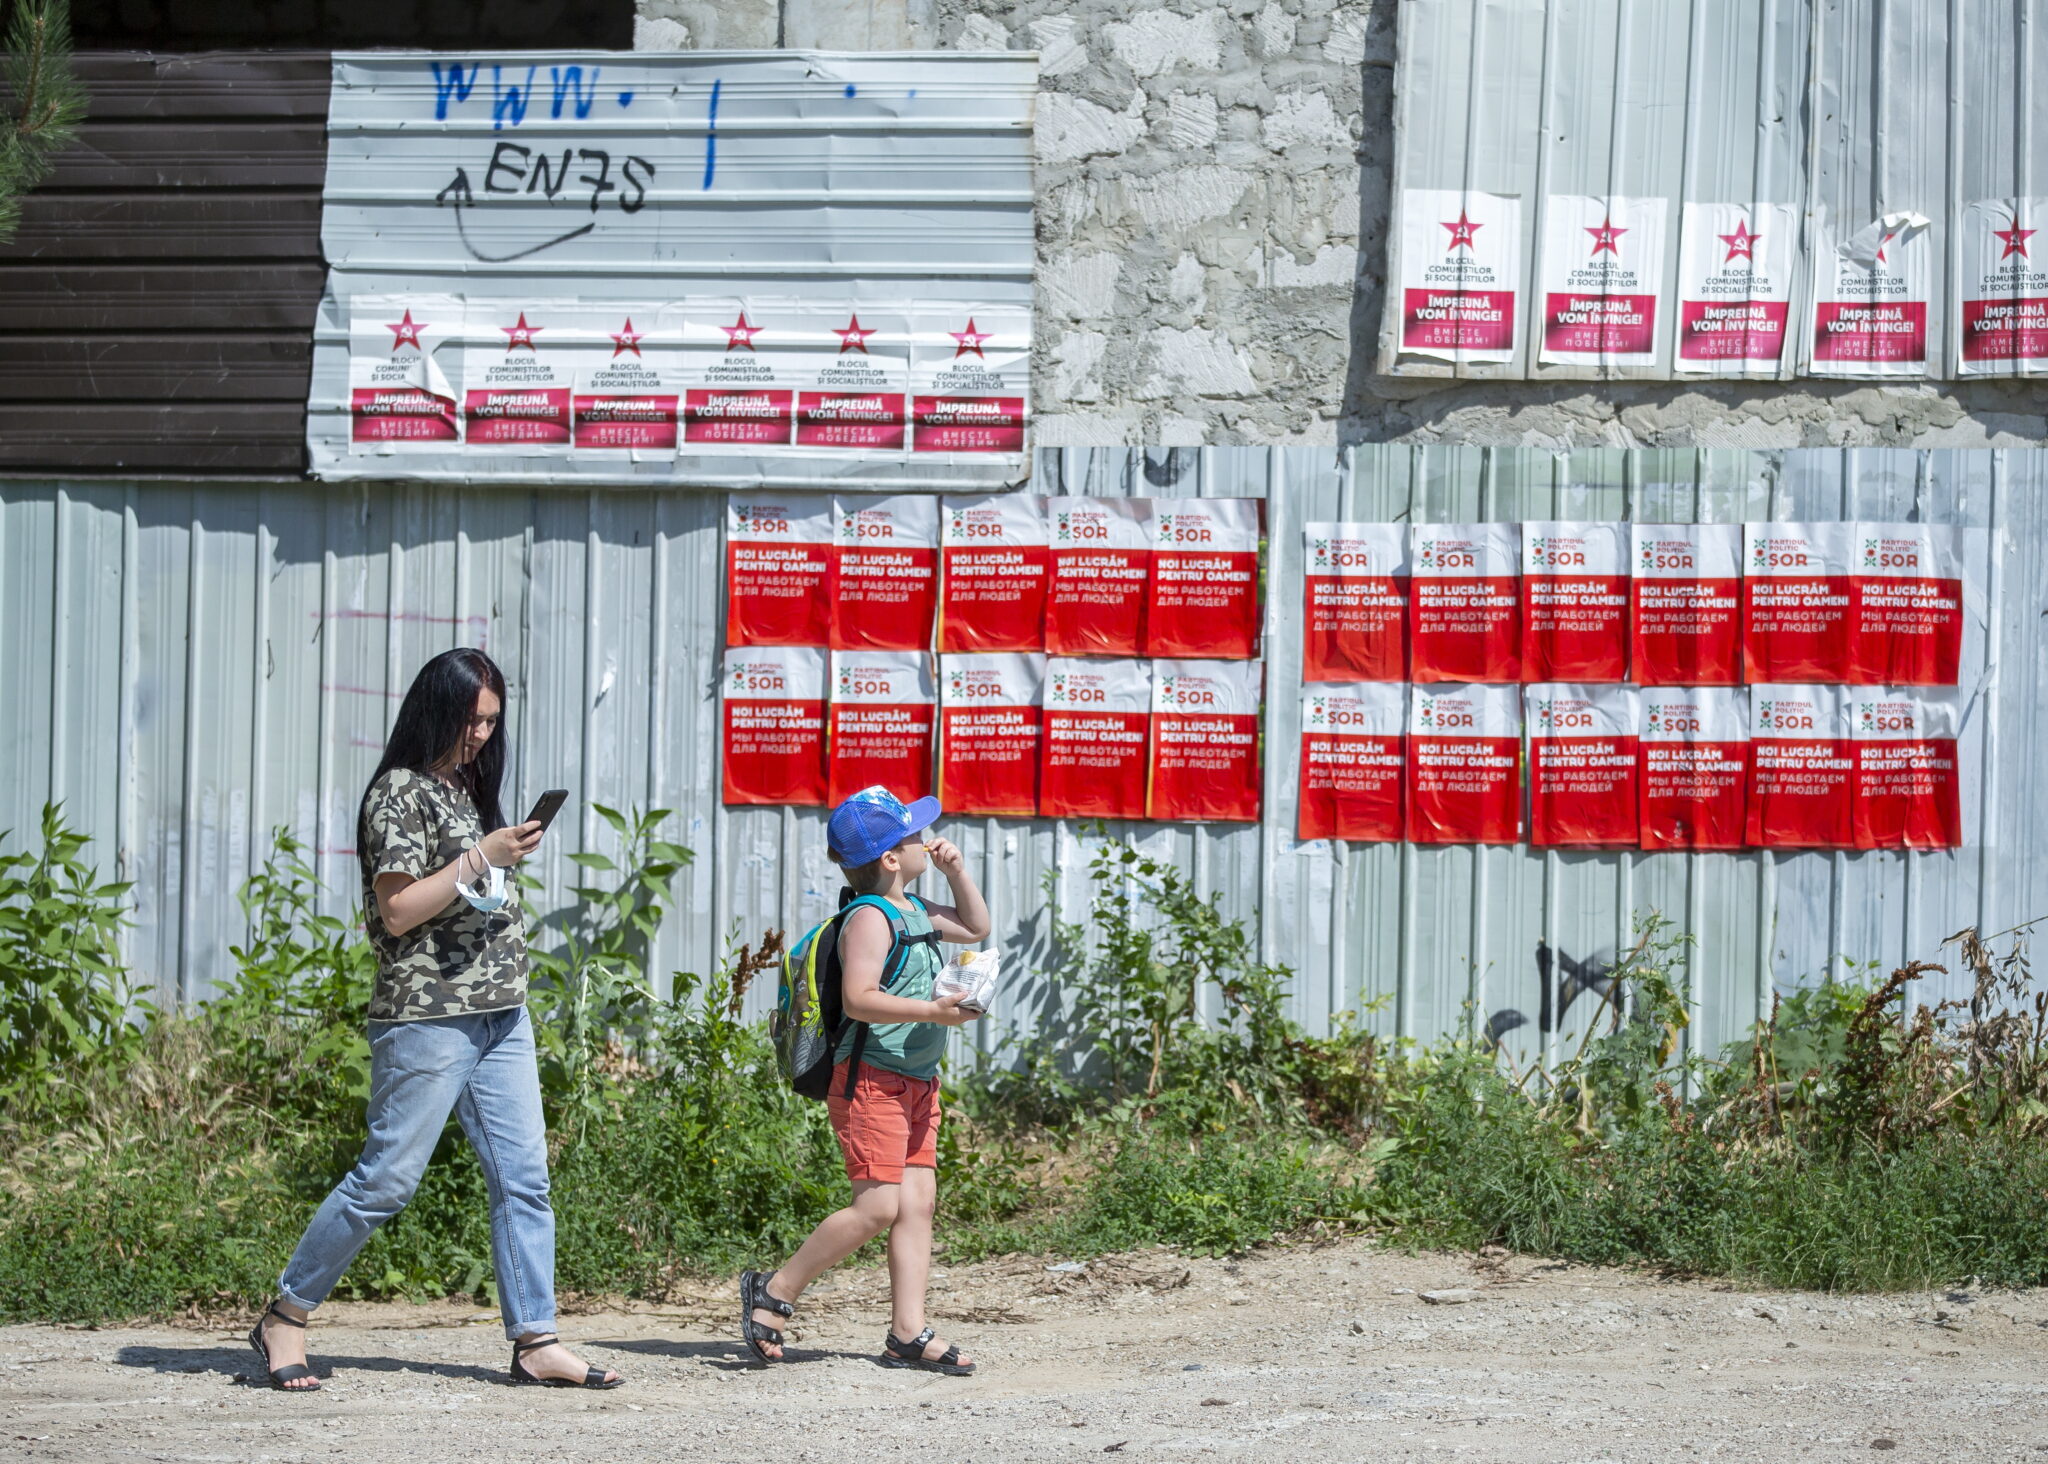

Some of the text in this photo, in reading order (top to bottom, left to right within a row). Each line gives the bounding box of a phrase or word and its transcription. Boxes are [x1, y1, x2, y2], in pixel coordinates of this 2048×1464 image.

[1428, 295, 1490, 308] ÎMPREUNĂ
[1416, 309, 1446, 320] VOM
[1557, 313, 1587, 324] VOM
[1692, 320, 1722, 331] VOM
[1827, 321, 1857, 332] VOM
[487, 393, 548, 405] ÎMPREUNĂ
[708, 395, 770, 407] ÎMPREUNĂ
[821, 396, 882, 411] ÎMPREUNĂ
[594, 399, 654, 411] ÎMPREUNĂ
[936, 400, 1000, 414] ÎMPREUNĂ
[475, 406, 504, 417] VOM
[695, 406, 780, 418] VOM ÎNVINGE!
[808, 409, 893, 421] VOM ÎNVINGE!
[924, 414, 952, 424] VOM
[736, 549, 755, 559] NOI
[841, 554, 860, 564] NOI
[951, 555, 971, 564] NOI
[1056, 556, 1075, 566] NOI
[1159, 559, 1178, 569] NOI
[735, 562, 826, 572] PENTRU OAMENI
[840, 566, 930, 577] PENTRU OAMENI
[951, 565, 1042, 576] PENTRU OAMENI
[1055, 568, 1145, 579] PENTRU OAMENI
[1159, 571, 1250, 582] PENTRU OAMENI
[840, 581, 923, 591] МЫ РАБОТАЕМ
[1314, 584, 1334, 594] NOI
[1421, 586, 1441, 595] NOI
[1531, 583, 1551, 593] NOI
[1640, 586, 1660, 596] NOI
[1752, 585, 1773, 595] NOI
[1863, 584, 1883, 594] NOI
[839, 592, 909, 602] ДЛЯ ЛЮДЕЙ
[1421, 596, 1515, 607] PENTRU OAMENI
[1531, 595, 1625, 606] PENTRU OAMENI
[1752, 596, 1849, 607] PENTRU OAMENI
[1640, 598, 1734, 609] PENTRU OAMENI
[1863, 597, 1956, 609] PENTRU OAMENI
[1531, 610, 1618, 620] МЫ РАБОТАЕМ
[1752, 611, 1842, 621] МЫ РАБОТАЕМ
[1531, 621, 1603, 631] ДЛЯ ЛЮДЕЙ
[1752, 622, 1826, 633] ДЛЯ ЛЮДЕЙ
[733, 707, 752, 717] NOI
[839, 712, 858, 721] NOI
[733, 719, 775, 729] PENTRU
[951, 715, 970, 725] NOI
[1052, 719, 1072, 728] NOI
[839, 723, 881, 733] PENTRU
[1162, 721, 1181, 731] NOI
[1052, 731, 1143, 742] PENTRU OAMENI
[1161, 733, 1252, 744] PENTRU OAMENI
[1310, 742, 1330, 751] NOI
[1419, 744, 1439, 754] NOI
[1539, 746, 1559, 755] NOI
[1757, 746, 1777, 756] NOI
[1310, 754, 1354, 764] PENTRU
[1648, 750, 1668, 760] NOI
[1419, 756, 1512, 767] PENTRU OAMENI
[1589, 756, 1634, 766] OAMENI
[1757, 759, 1852, 769] PENTRU OAMENI
[1649, 761, 1741, 772] PENTRU OAMENI
